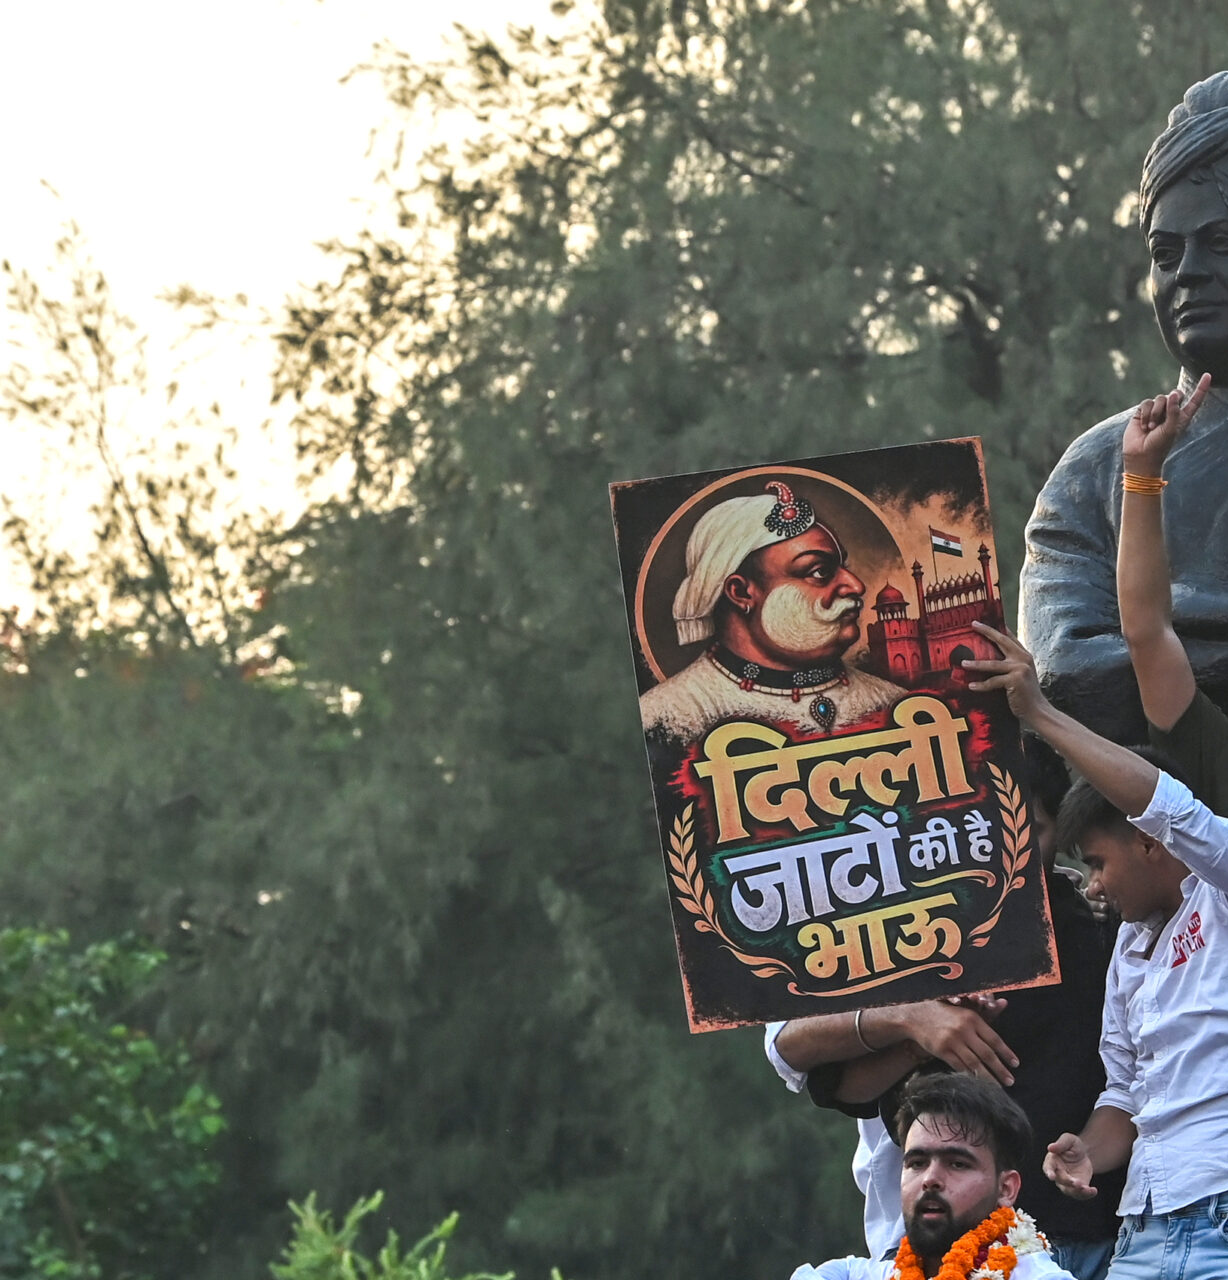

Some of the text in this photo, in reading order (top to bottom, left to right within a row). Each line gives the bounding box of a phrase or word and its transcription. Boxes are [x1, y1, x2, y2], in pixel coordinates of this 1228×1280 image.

[694, 696, 974, 844] दिल्ली
[724, 810, 995, 933] जाटों की है
[797, 892, 963, 982] भाऊ
